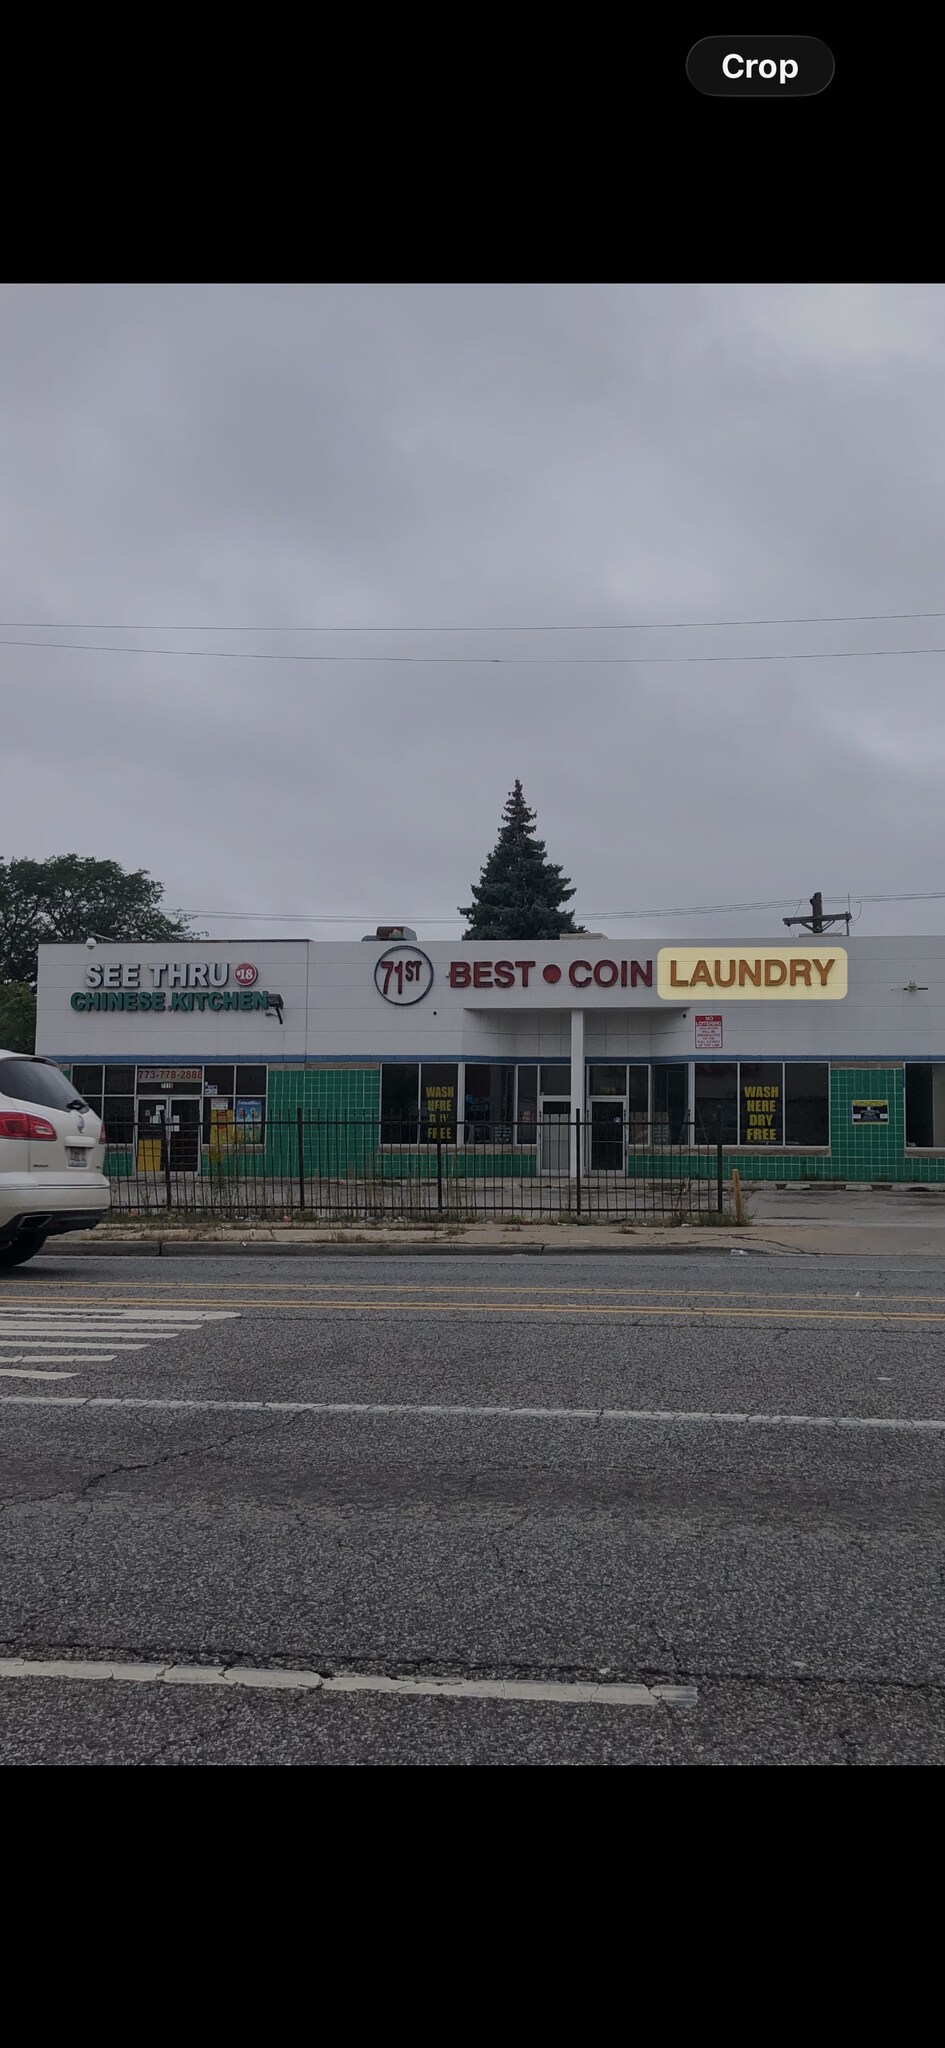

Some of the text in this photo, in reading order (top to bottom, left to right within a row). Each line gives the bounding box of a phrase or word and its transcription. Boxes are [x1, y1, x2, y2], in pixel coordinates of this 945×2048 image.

[84, 962, 140, 988] SEE
[148, 962, 229, 988] THRU
[380, 959, 423, 995] 71ST
[450, 958, 836, 988] BEST COIN LAUNDRY
[70, 990, 270, 1012] CHINESE KITCHEN
[426, 1086, 454, 1098] WASH
[744, 1086, 779, 1098] WASH
[746, 1100, 776, 1112] HERE
[750, 1114, 773, 1127] DRY
[427, 1127, 452, 1139] FREE
[746, 1128, 777, 1141] FREE
